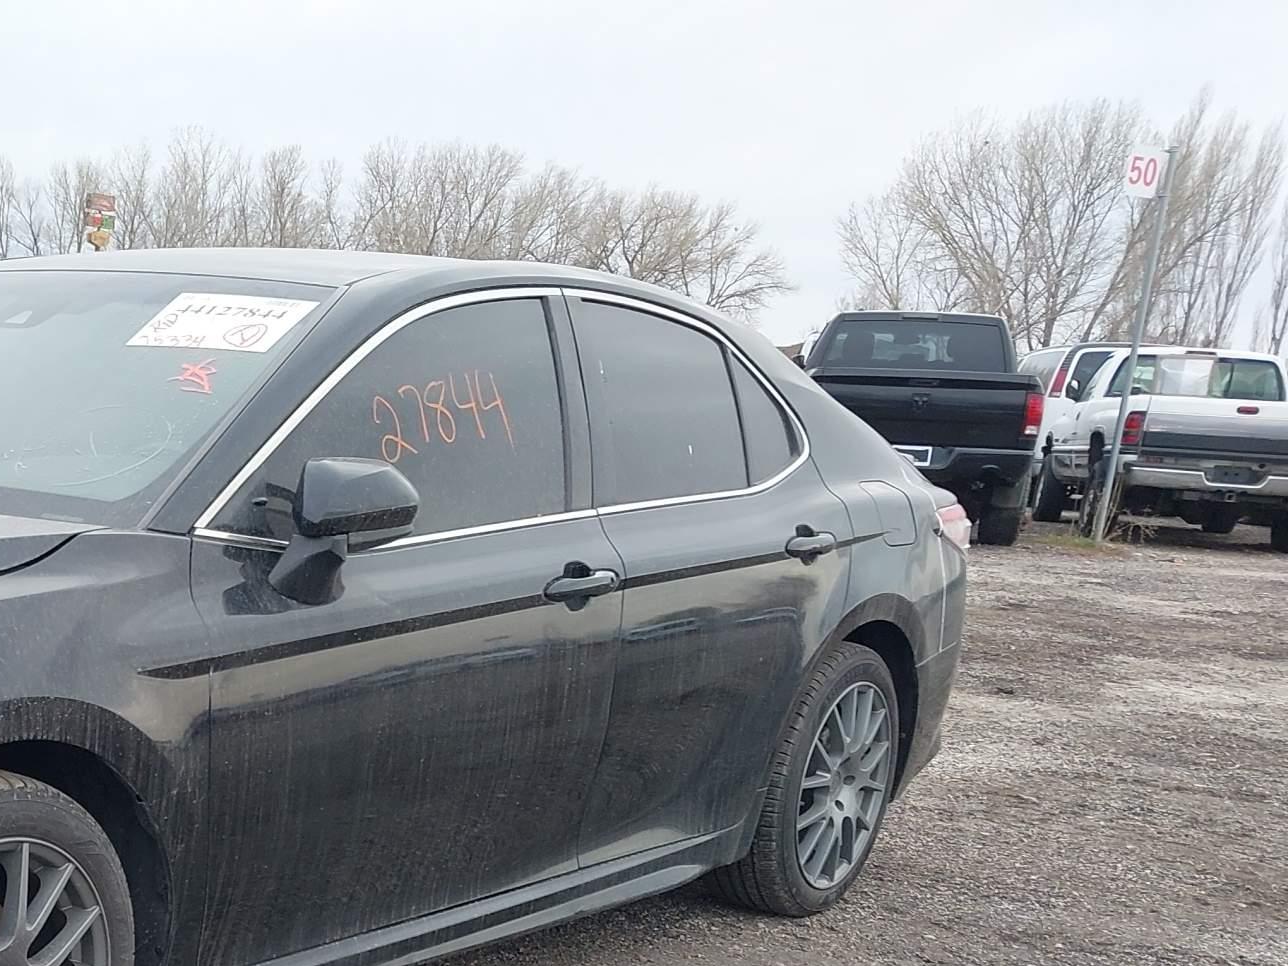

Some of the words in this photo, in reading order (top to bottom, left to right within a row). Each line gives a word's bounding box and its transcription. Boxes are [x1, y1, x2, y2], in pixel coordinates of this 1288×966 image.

[1128, 156, 1158, 187] 50
[176, 304, 289, 320] 44127844
[372, 369, 516, 463] 27844
